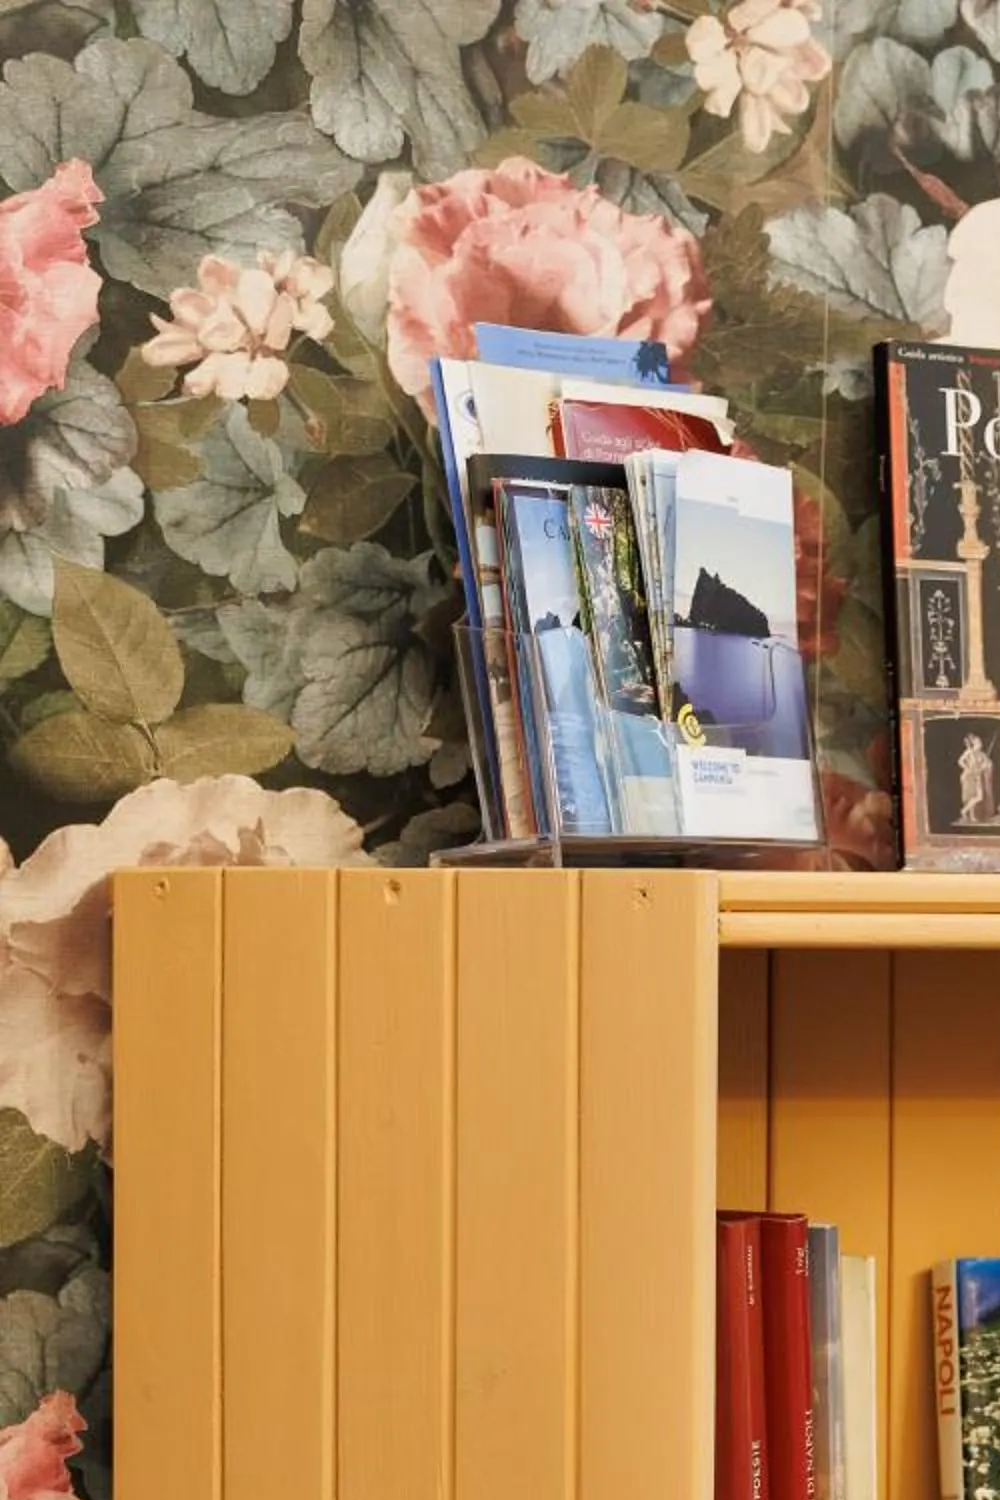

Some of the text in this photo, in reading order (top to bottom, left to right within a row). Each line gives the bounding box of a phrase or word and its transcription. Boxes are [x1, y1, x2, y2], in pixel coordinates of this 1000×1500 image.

[936, 1284, 955, 1417] NAPOLI
[751, 1439, 763, 1500] POESIE
[804, 1408, 815, 1473] NAPOLI
